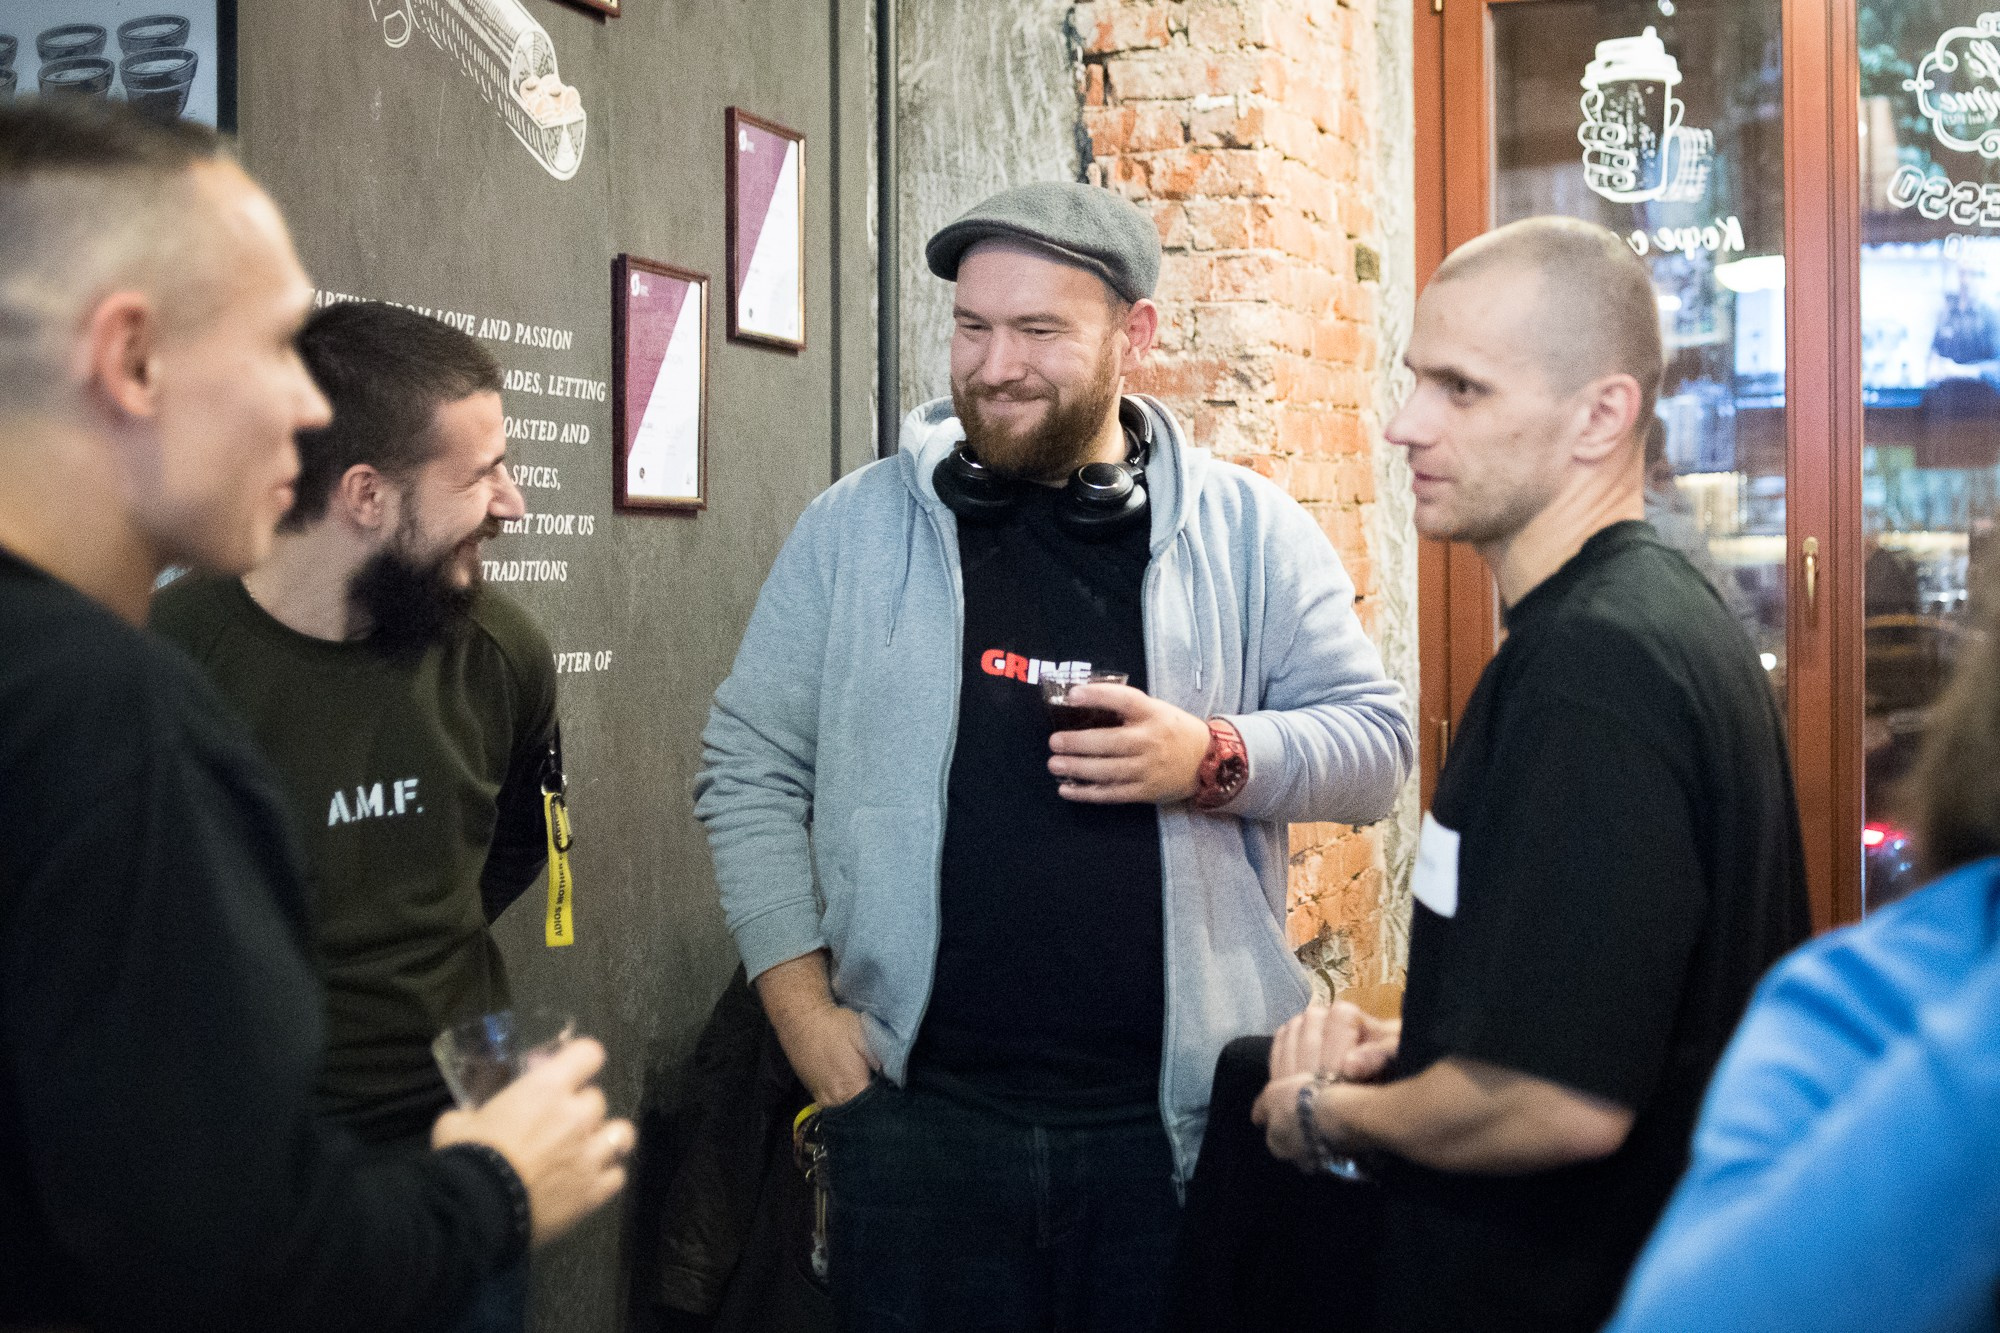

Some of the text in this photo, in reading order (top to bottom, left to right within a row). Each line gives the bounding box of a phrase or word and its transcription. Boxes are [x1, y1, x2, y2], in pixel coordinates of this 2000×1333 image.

[478, 315, 511, 342] AND
[514, 322, 573, 350] PASSION
[502, 369, 607, 402] ADES, LETTING
[559, 423, 591, 445] AND
[511, 464, 561, 490] SPICES,
[535, 513, 576, 536] TOOK
[577, 514, 595, 536] US
[481, 560, 568, 582] TRADITIONS
[553, 650, 613, 674] PTER OF
[327, 778, 424, 827] A.M.F.
[554, 906, 563, 937] ADIOS
